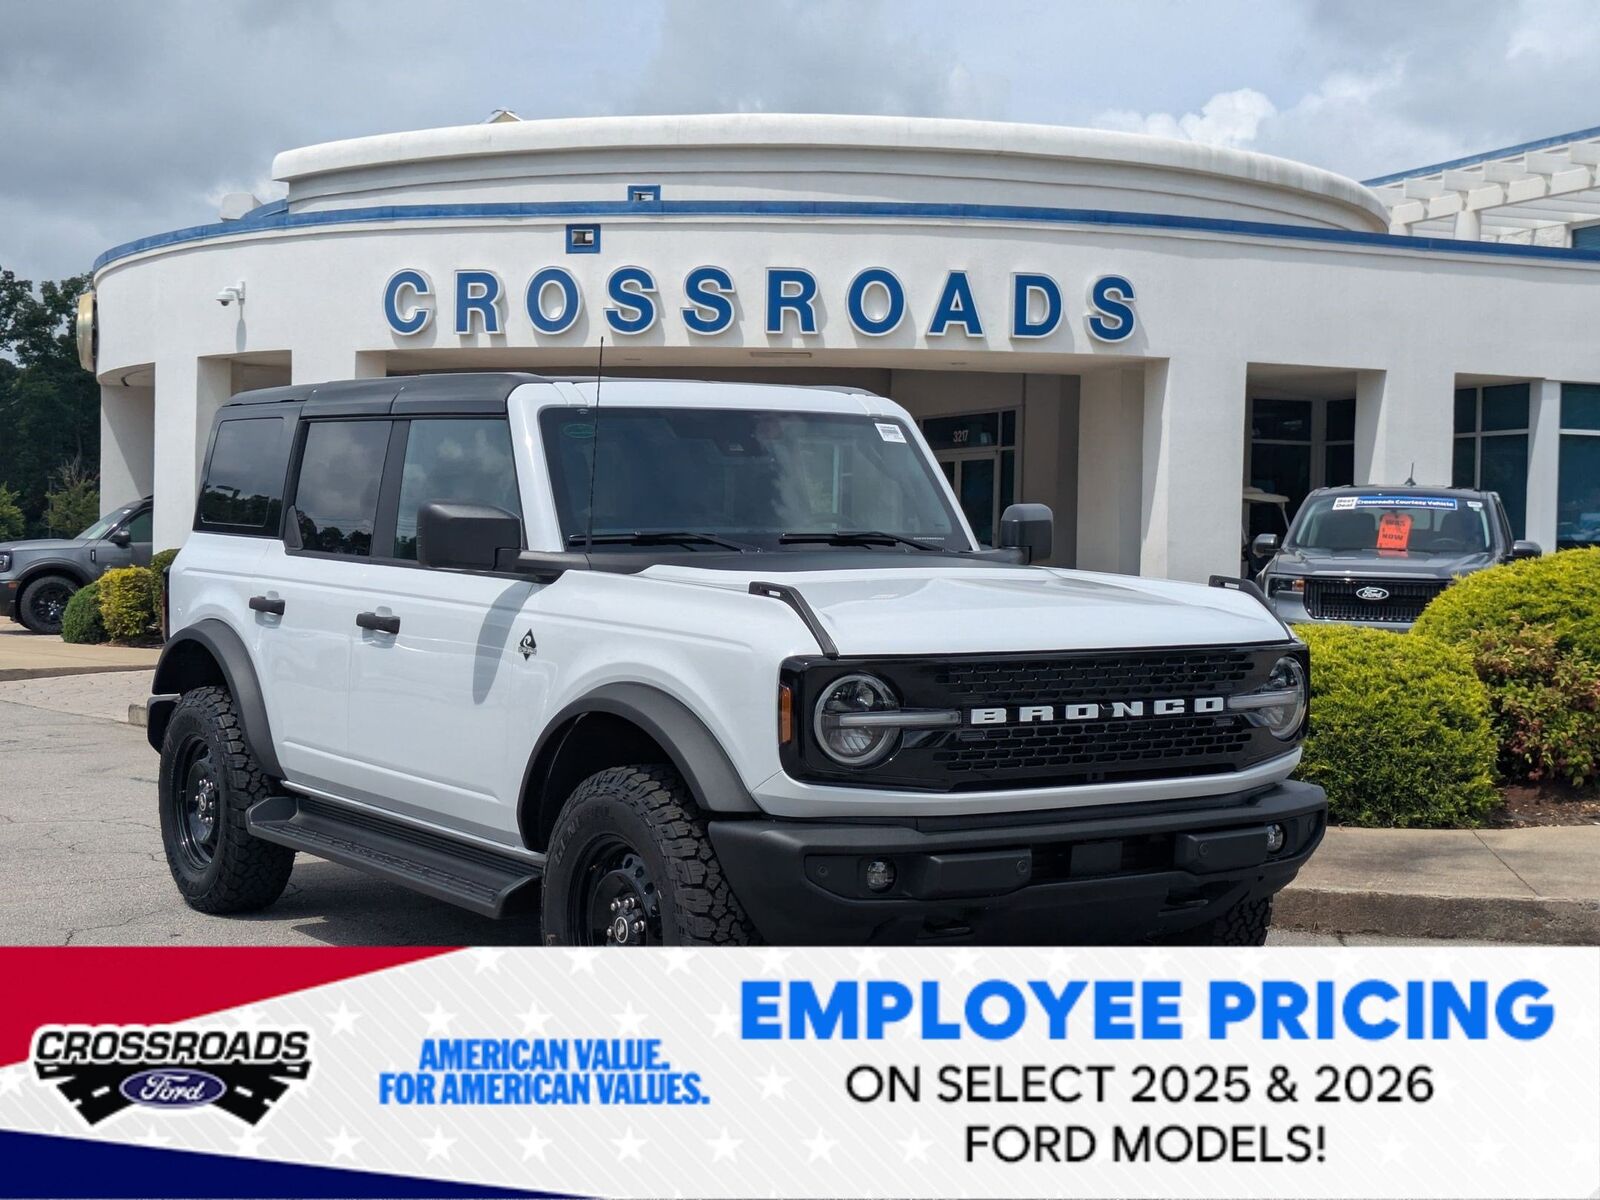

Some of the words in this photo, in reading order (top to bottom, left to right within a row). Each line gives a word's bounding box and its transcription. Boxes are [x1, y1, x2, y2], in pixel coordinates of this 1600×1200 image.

[384, 266, 1136, 343] CROSSROADS
[953, 429, 969, 443] 3217
[1382, 533, 1404, 541] NOW
[1361, 587, 1384, 598] Ford
[970, 696, 1225, 726] BRONCO
